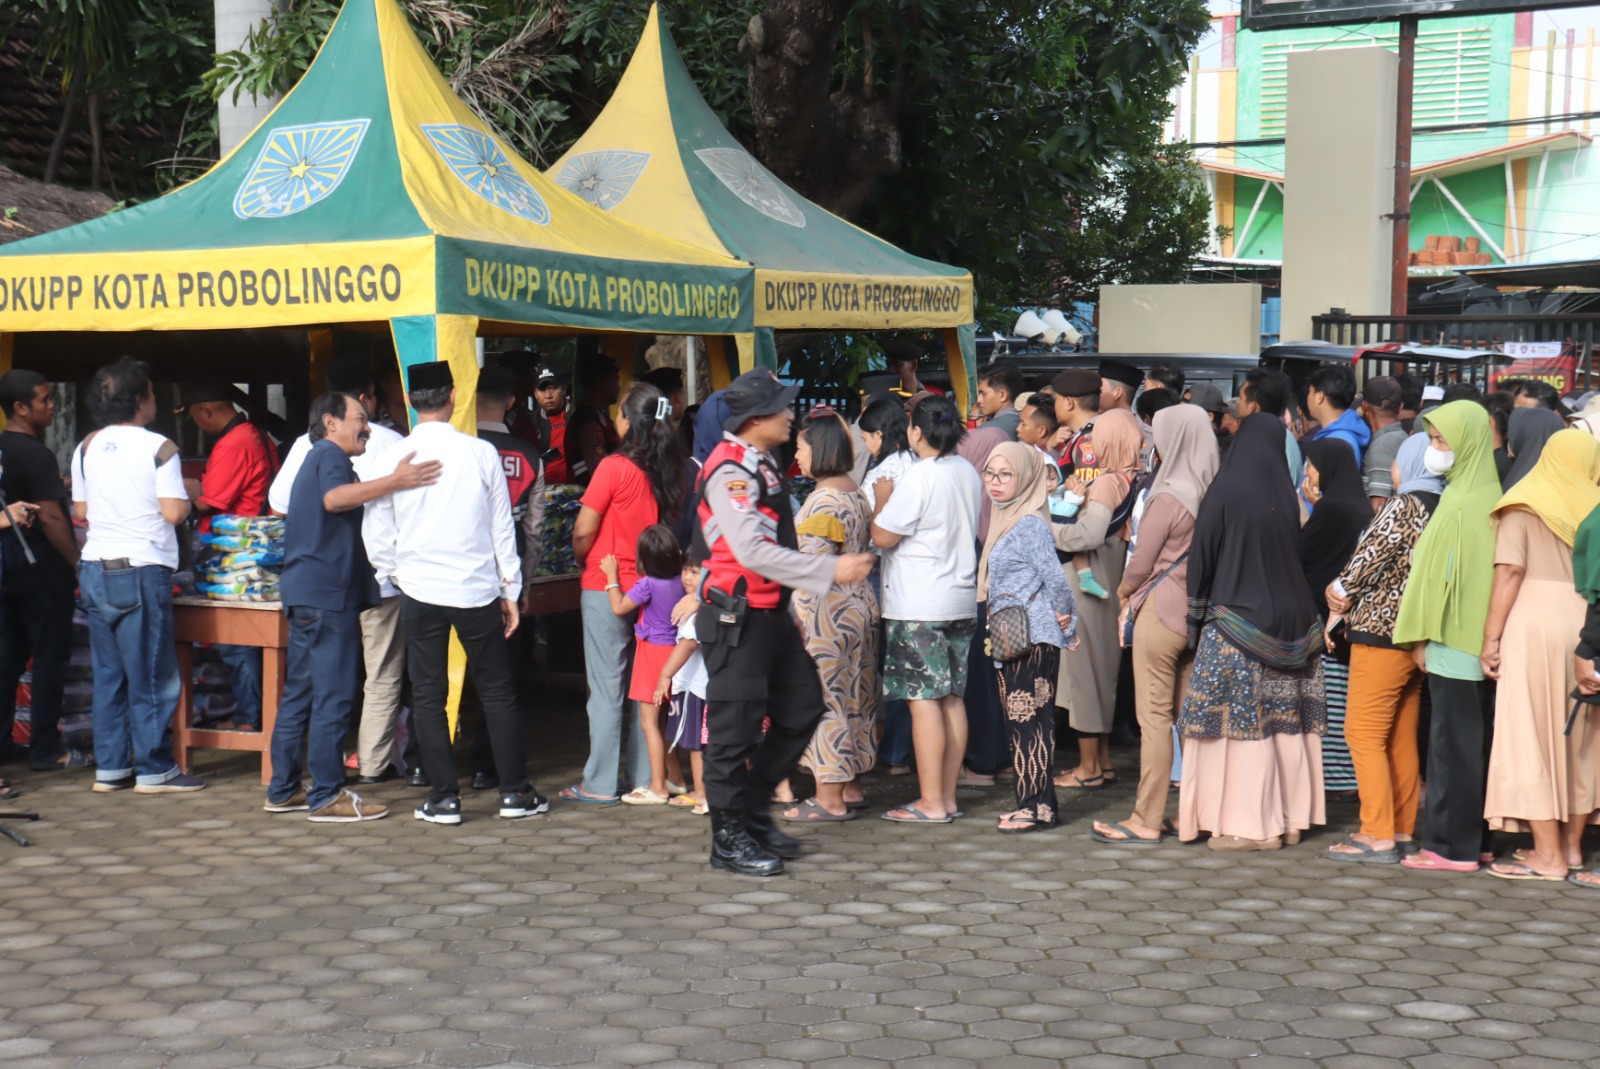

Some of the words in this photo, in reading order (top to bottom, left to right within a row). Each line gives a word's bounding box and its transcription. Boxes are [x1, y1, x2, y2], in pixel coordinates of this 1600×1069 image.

[94, 273, 169, 310] KOTA
[177, 263, 401, 308] PROBOLINGGO
[465, 258, 541, 303] DKUPP
[545, 269, 602, 310] KOTA
[606, 276, 739, 319] PROBOLINGGO
[765, 281, 817, 311] DKUPP
[822, 282, 860, 312] KOTA
[864, 284, 960, 312] PROBOLINGGO
[499, 455, 520, 477] SI
